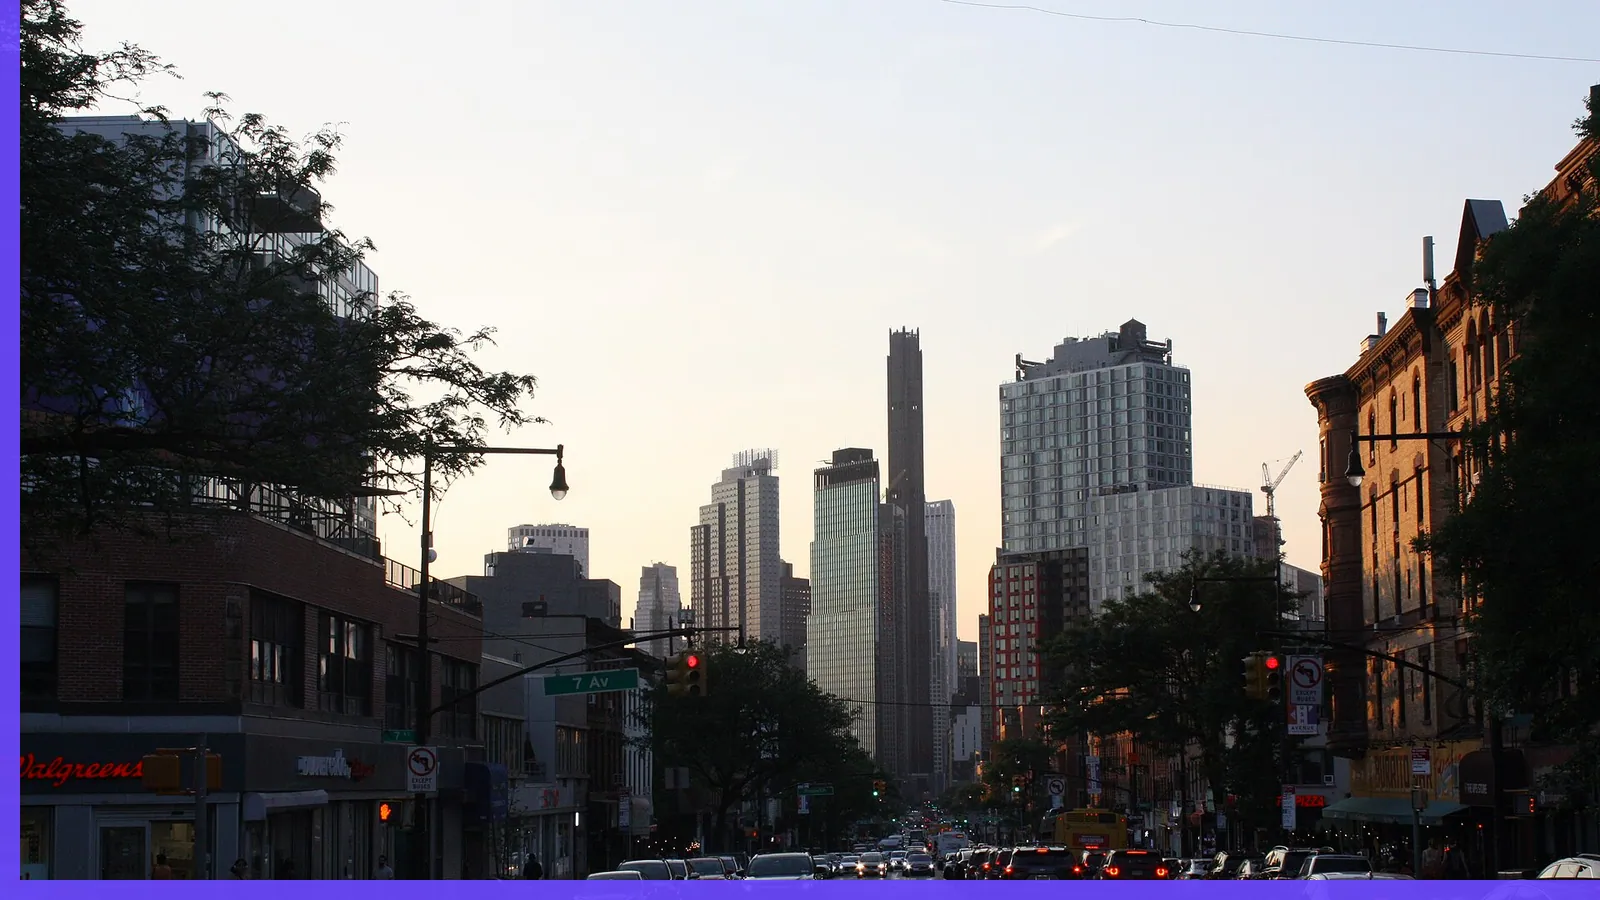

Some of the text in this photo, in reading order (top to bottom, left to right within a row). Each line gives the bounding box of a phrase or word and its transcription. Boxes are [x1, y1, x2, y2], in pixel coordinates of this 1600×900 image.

[572, 676, 609, 690] 7 Av
[393, 731, 400, 741] 7
